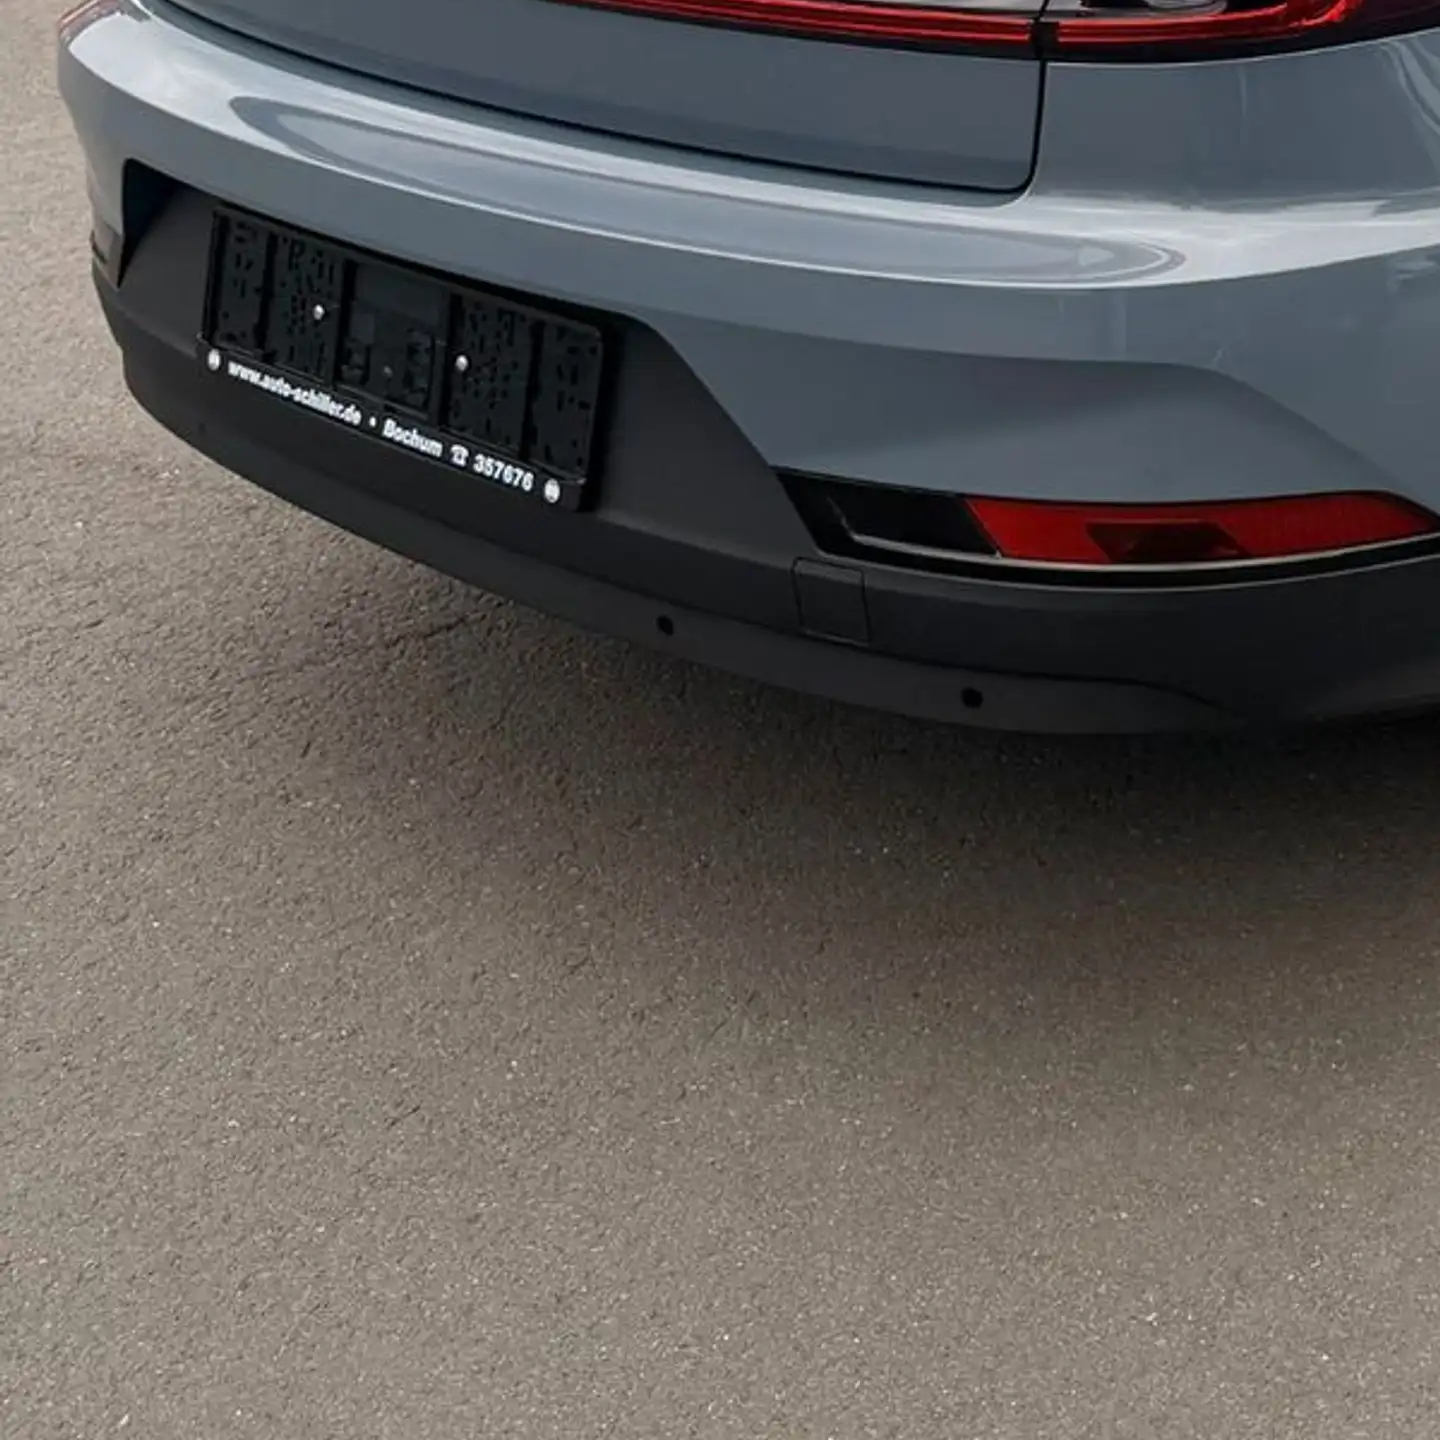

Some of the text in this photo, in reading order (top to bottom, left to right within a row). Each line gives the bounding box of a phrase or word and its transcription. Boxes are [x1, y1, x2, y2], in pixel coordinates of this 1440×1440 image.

[228, 361, 534, 492] www.auto-schiller.de Bochum 357676
